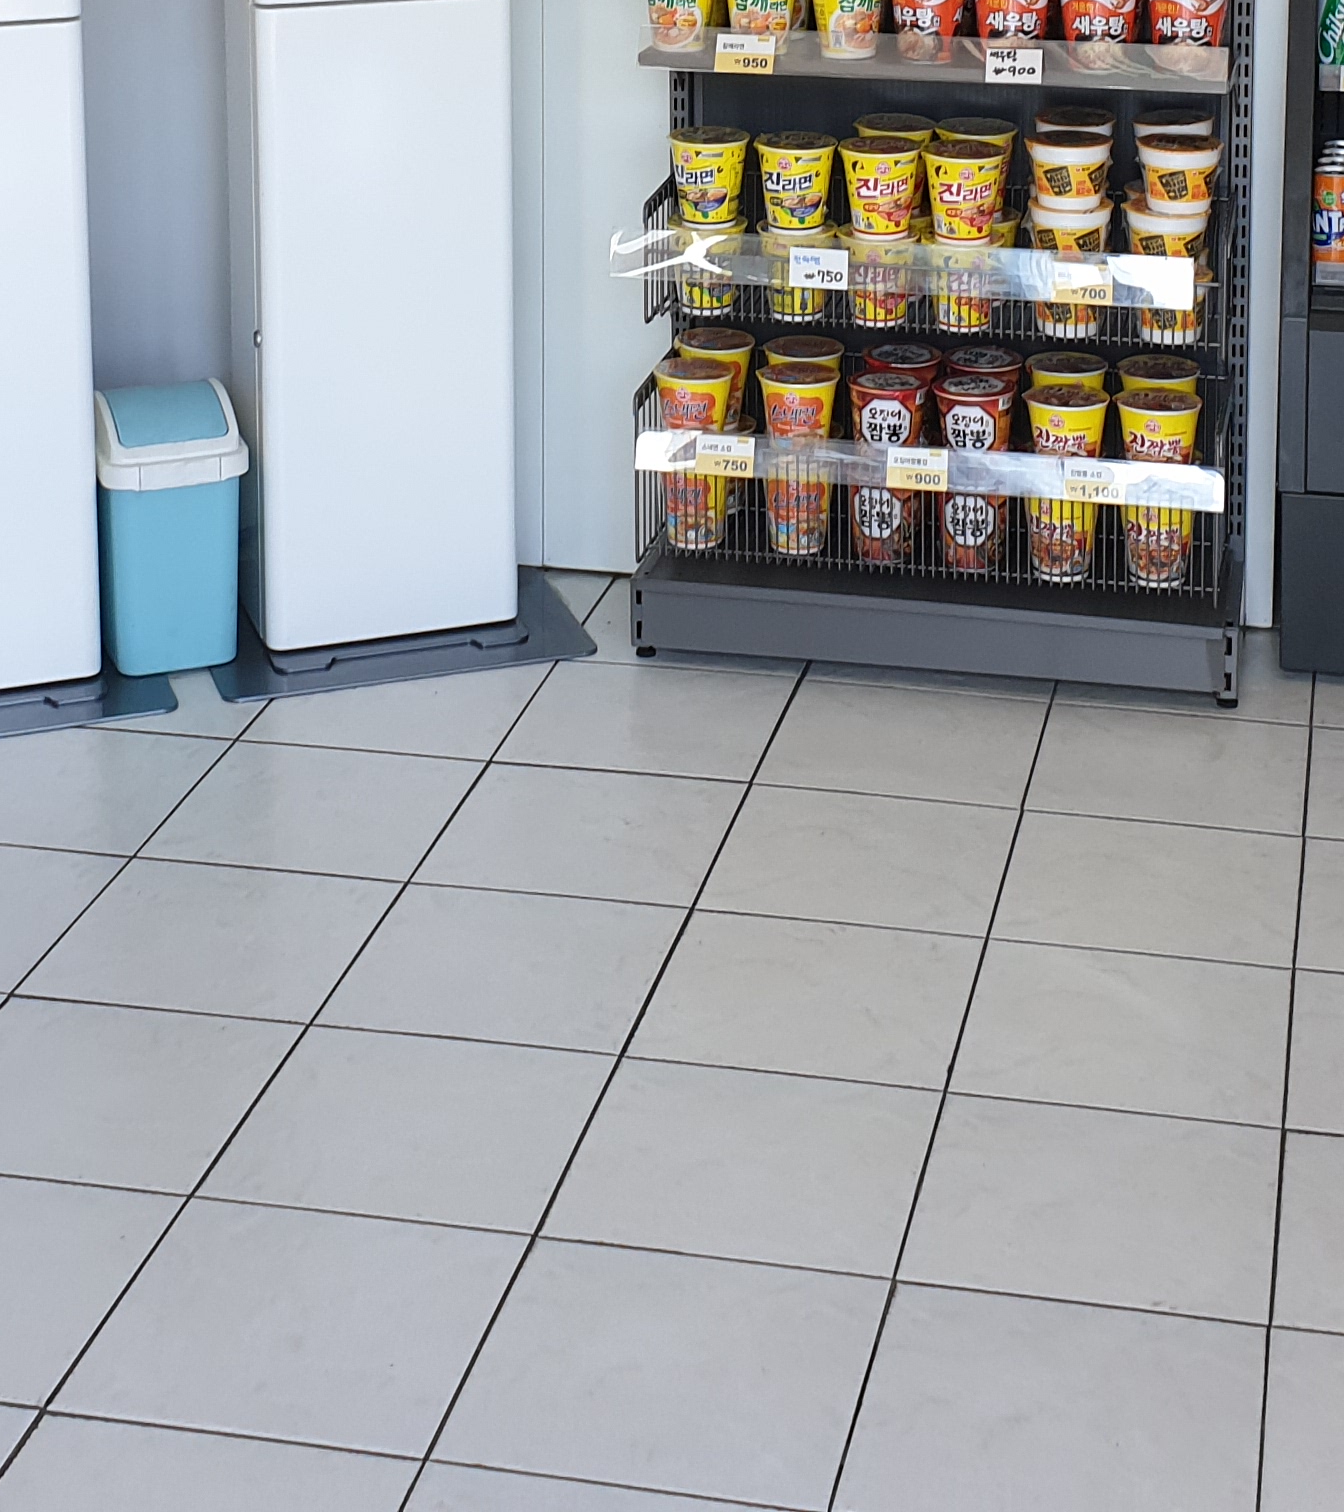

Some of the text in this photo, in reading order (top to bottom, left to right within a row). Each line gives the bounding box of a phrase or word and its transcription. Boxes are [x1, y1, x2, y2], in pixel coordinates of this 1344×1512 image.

[986, 12, 1037, 31] 새우탕
[1072, 16, 1125, 35] 새우탕
[1156, 18, 1207, 37] 새우탕
[734, 58, 768, 68] ₩950
[989, 50, 1017, 61] 새우탕
[993, 66, 1036, 76] ₩900
[764, 172, 813, 192] 진라면
[856, 177, 908, 198] 진라면
[938, 182, 992, 203] 진라면
[804, 270, 843, 283] ₩750
[1072, 288, 1106, 300] ₩700
[868, 408, 902, 421] 오징어
[951, 414, 984, 427] 오징어
[866, 422, 904, 442] 짬뽕
[950, 428, 986, 448] 짬뽕
[1035, 427, 1087, 451] 진짬뽕
[1129, 432, 1181, 455] 진짬뽕
[714, 460, 747, 471] ₩750
[906, 474, 940, 485] ₩900
[1070, 483, 1119, 499] ₩1,100
